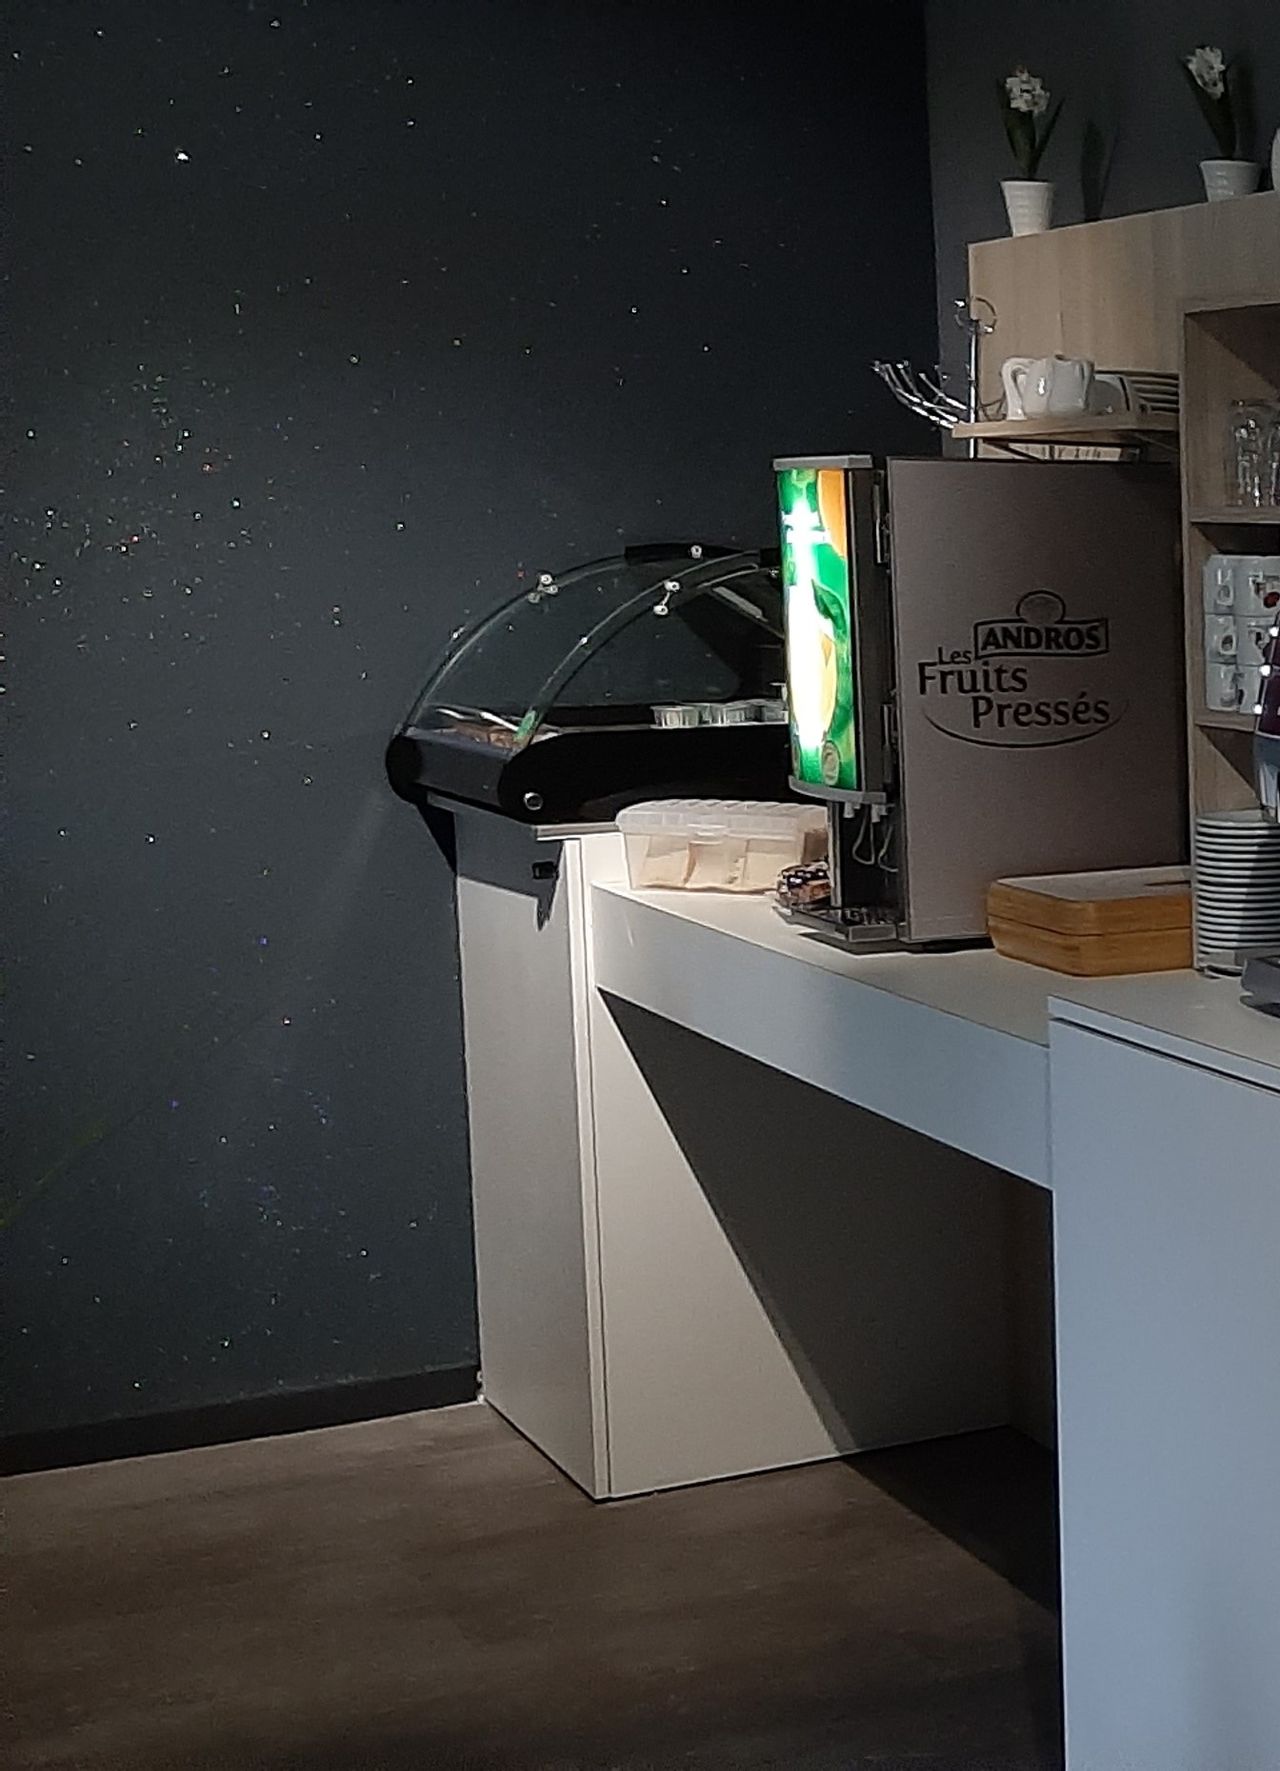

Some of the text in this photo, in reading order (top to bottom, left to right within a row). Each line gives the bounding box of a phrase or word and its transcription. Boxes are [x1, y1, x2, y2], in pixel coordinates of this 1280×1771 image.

[980, 624, 1101, 651] ANDROS
[937, 646, 973, 665] Les
[918, 660, 1028, 695] Fruits
[971, 691, 1110, 729] Pressés
